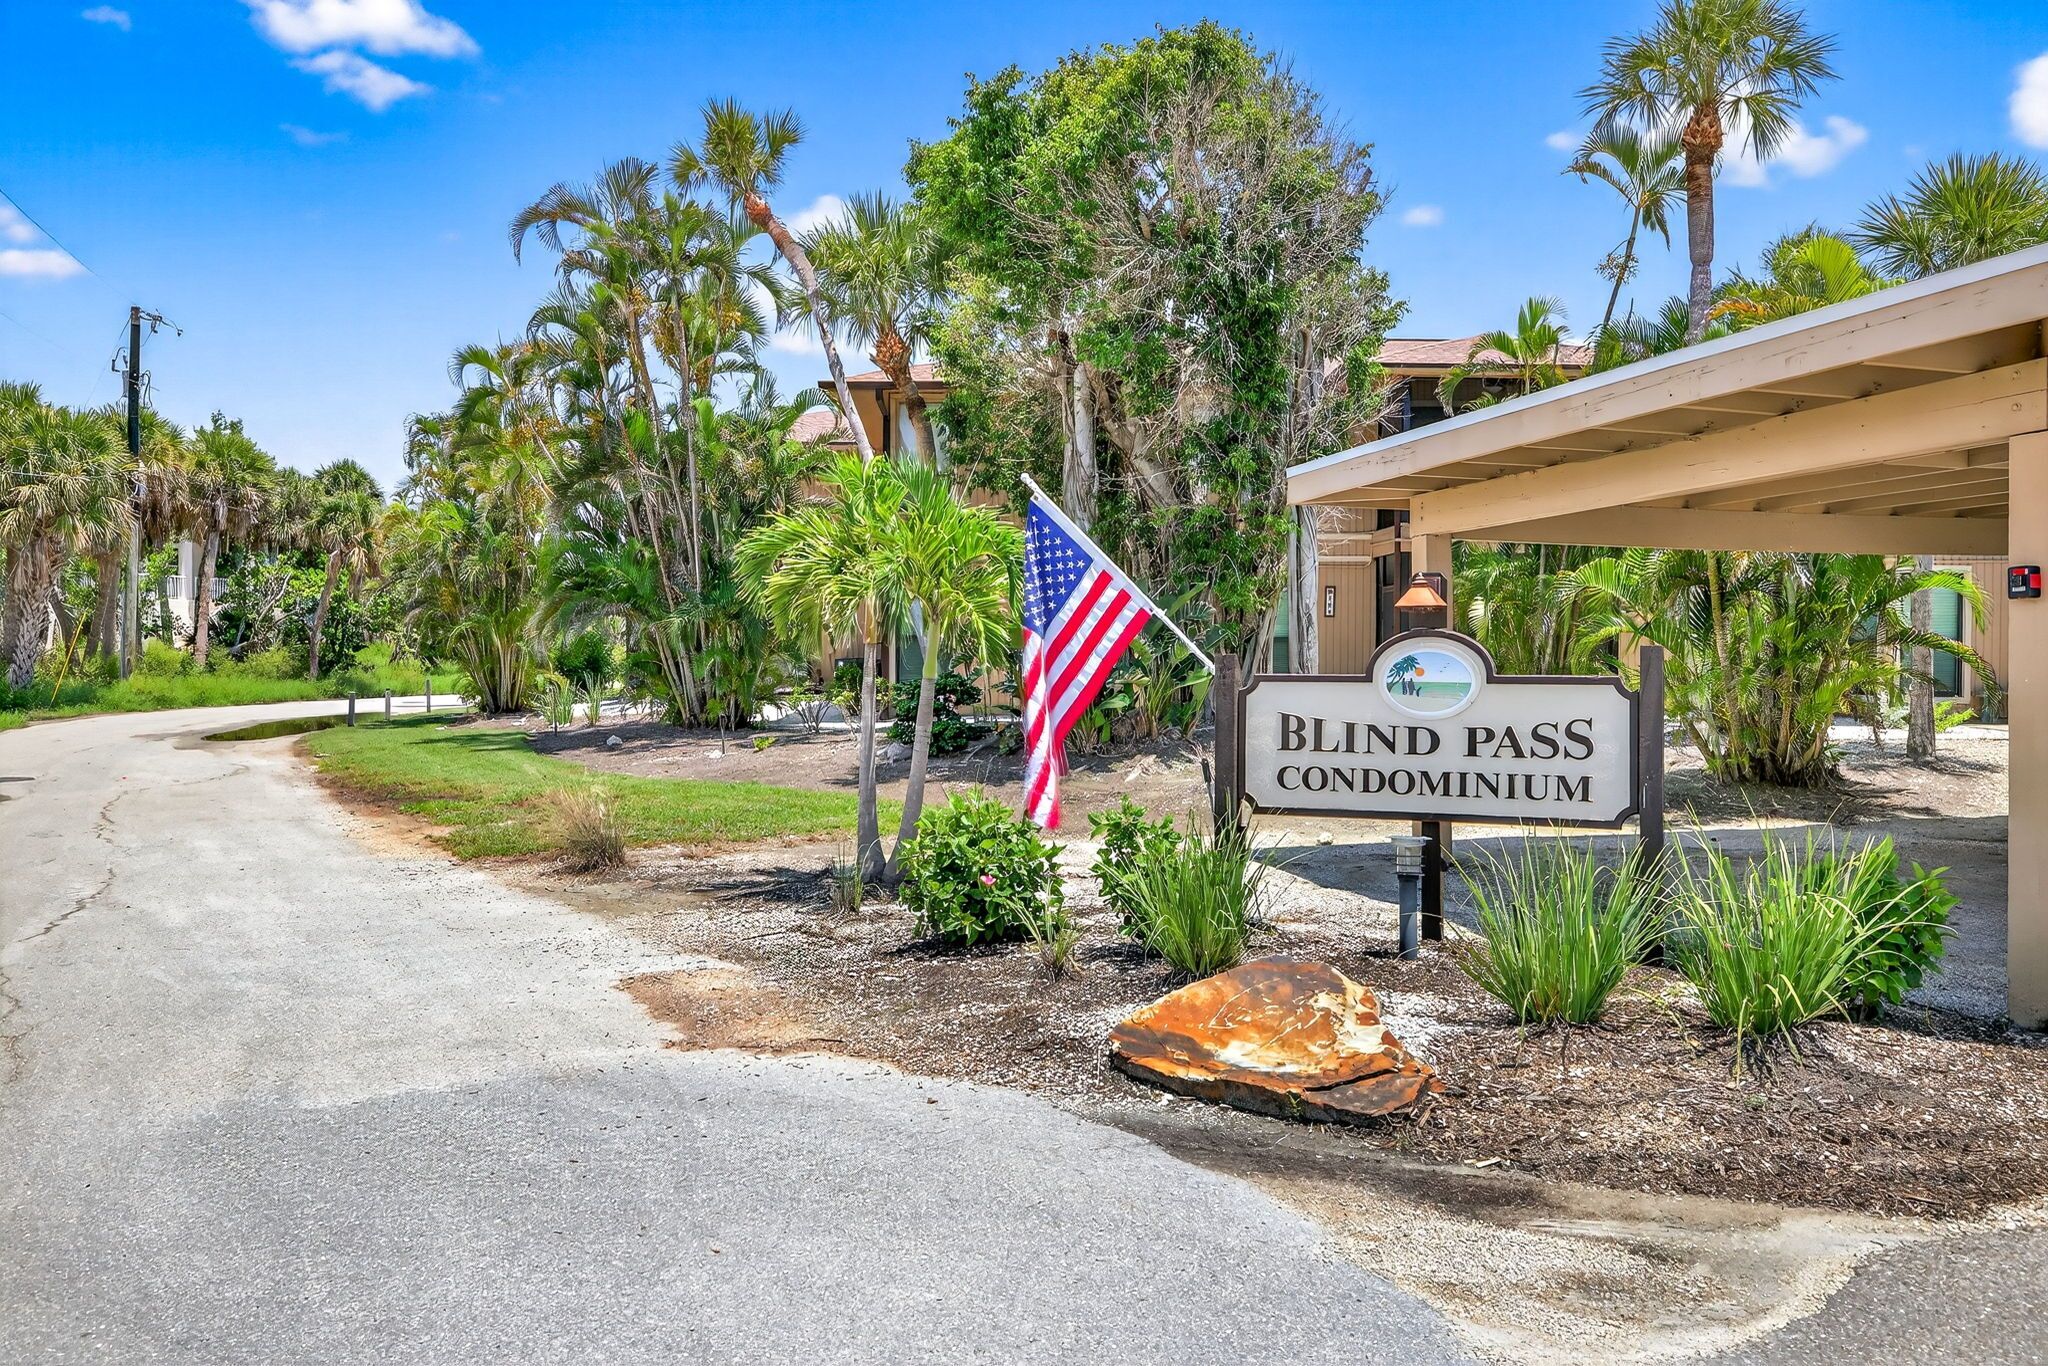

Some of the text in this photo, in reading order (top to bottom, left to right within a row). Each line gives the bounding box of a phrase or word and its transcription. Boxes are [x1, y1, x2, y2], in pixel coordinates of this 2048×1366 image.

[1276, 711, 1594, 761] BLIND PASS
[1276, 765, 1593, 803] CONDOMINIUM
